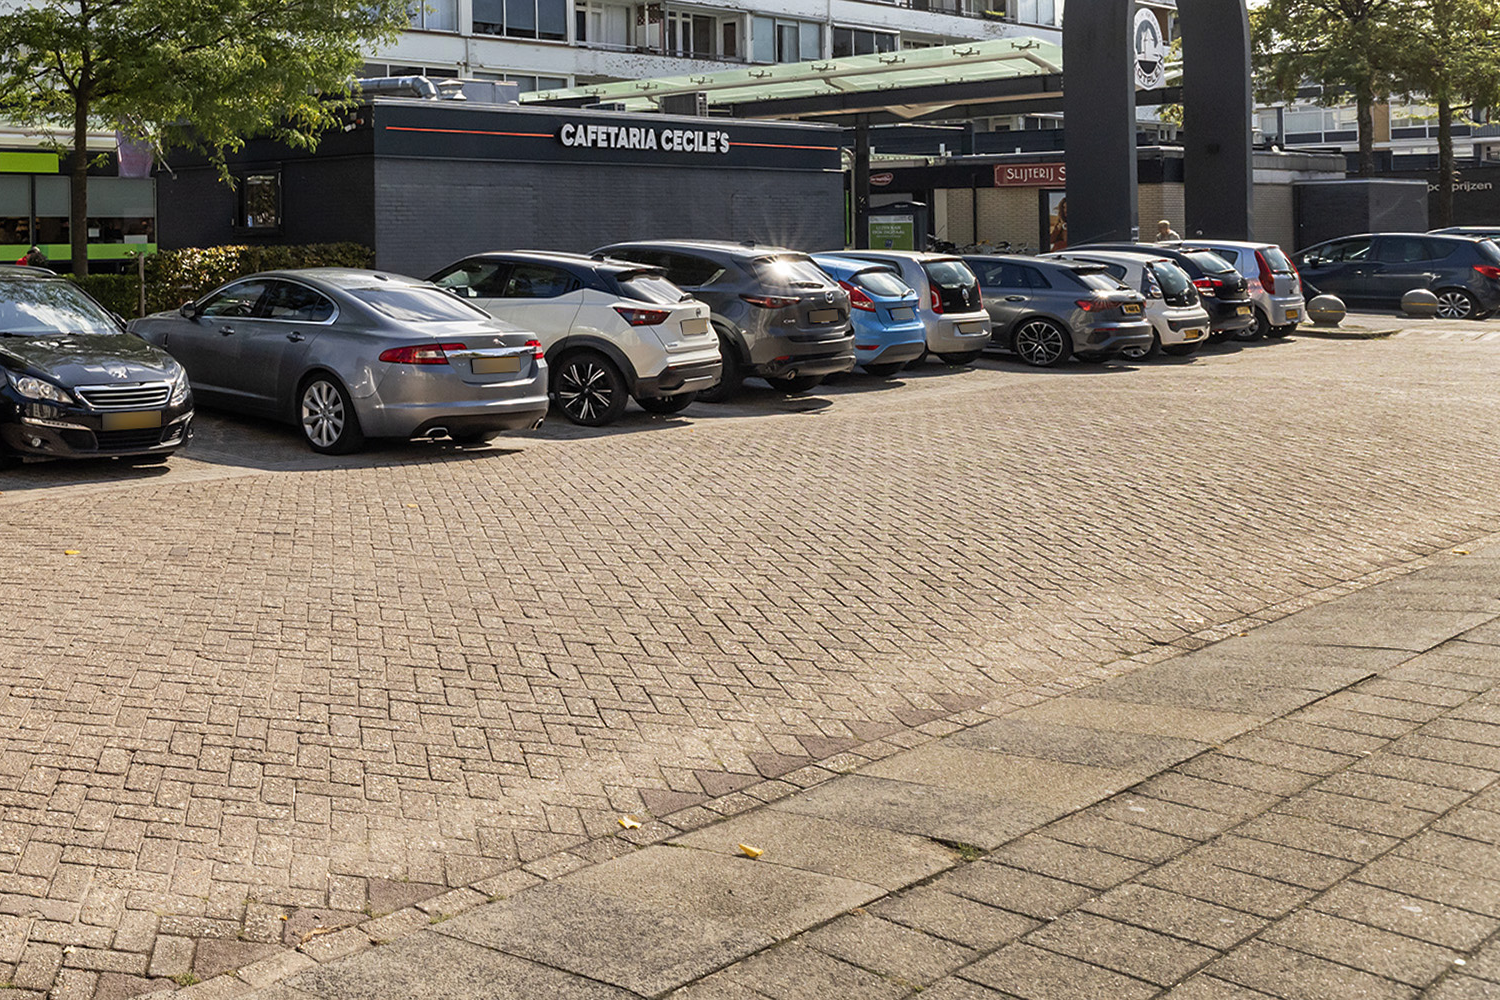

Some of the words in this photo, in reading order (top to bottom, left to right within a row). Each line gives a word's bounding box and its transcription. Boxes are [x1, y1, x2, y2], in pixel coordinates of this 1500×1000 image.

[560, 123, 658, 150] CAFETARIA
[660, 129, 730, 154] CECILE'S
[1006, 167, 1054, 182] SLIJTERIJ
